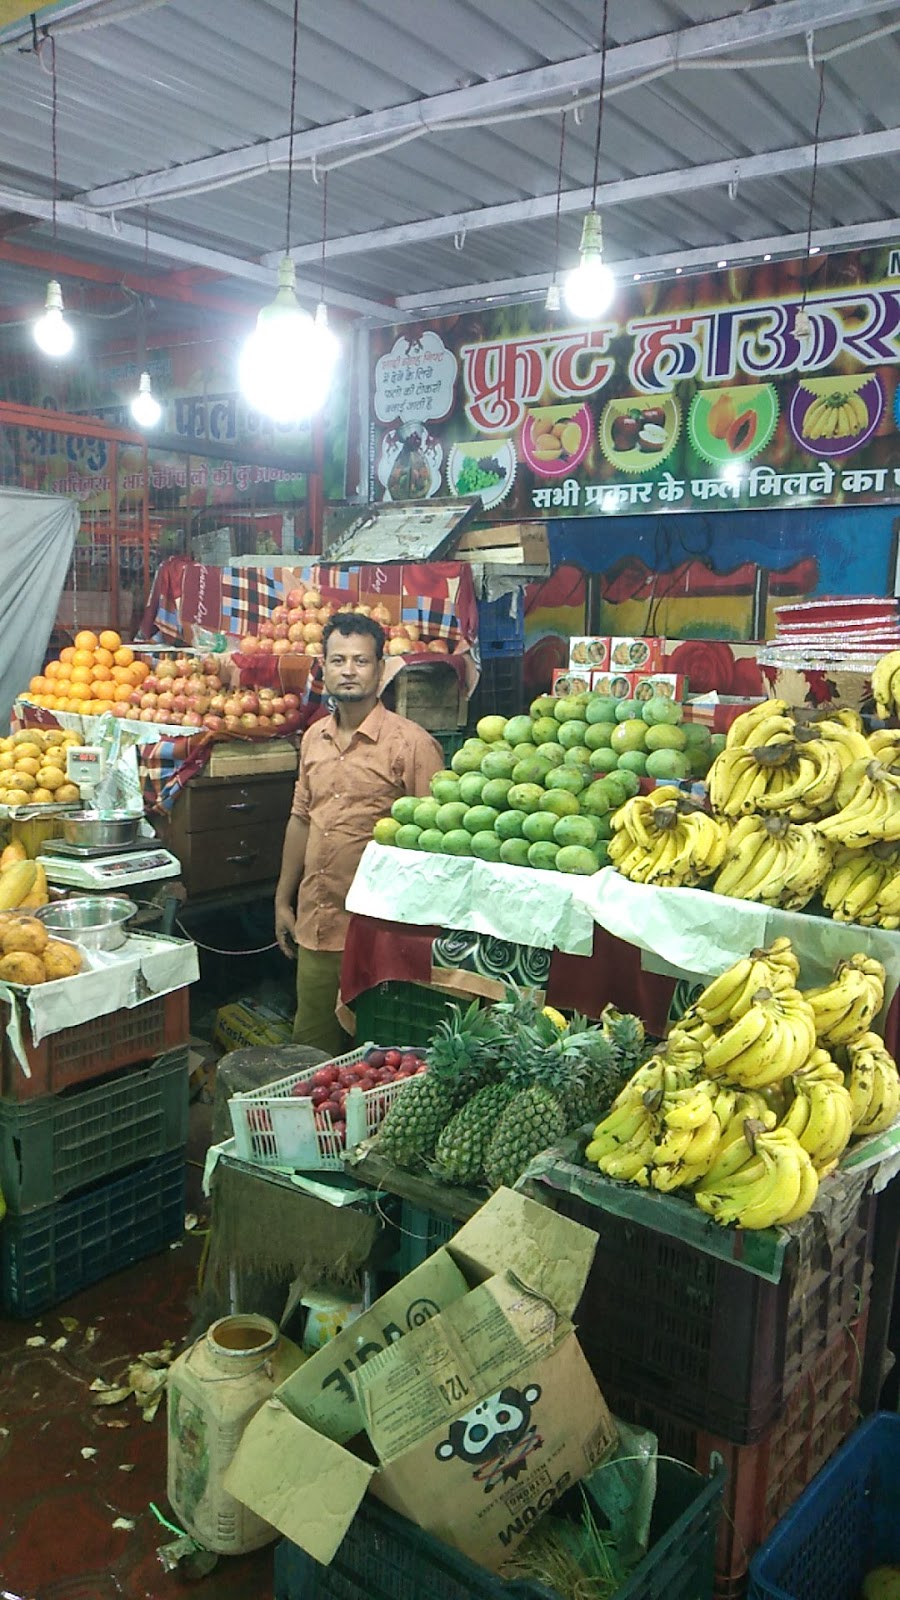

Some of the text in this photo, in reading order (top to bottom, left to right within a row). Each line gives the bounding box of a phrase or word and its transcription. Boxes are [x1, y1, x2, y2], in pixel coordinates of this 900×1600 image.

[532, 479, 580, 508] सभी
[585, 483, 653, 507] प्रकार
[658, 472, 685, 501] के
[748, 462, 836, 497] मिलने
[842, 468, 888, 493] का
[445, 1375, 470, 1401] 12
[508, 1476, 547, 1507] STRONG
